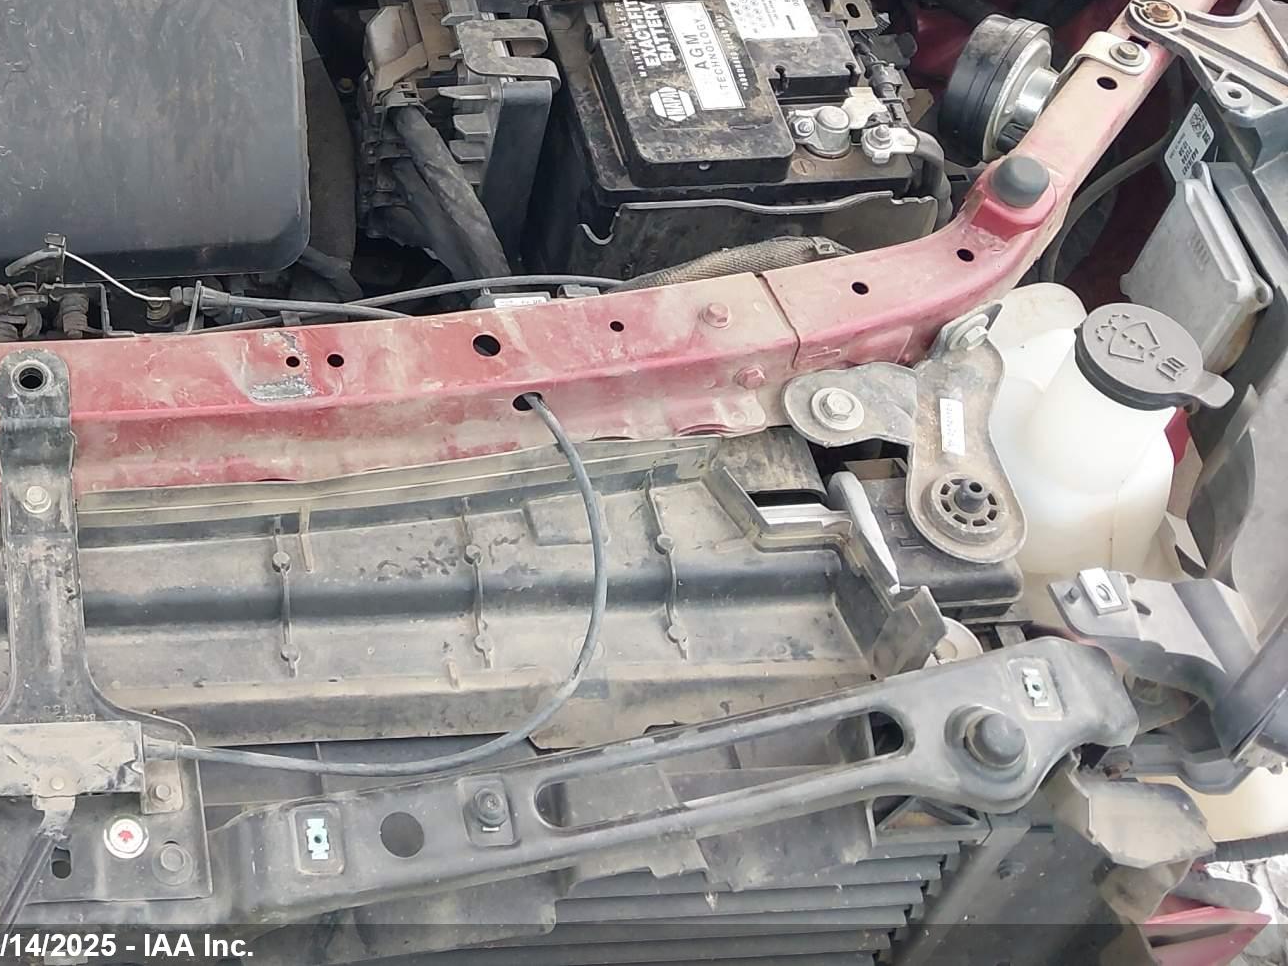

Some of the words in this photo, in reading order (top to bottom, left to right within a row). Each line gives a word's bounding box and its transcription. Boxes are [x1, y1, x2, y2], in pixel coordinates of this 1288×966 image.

[639, 1, 677, 62] BATTERY
[683, 33, 710, 70] AGM
[695, 18, 729, 90] TECHNOLOGY
